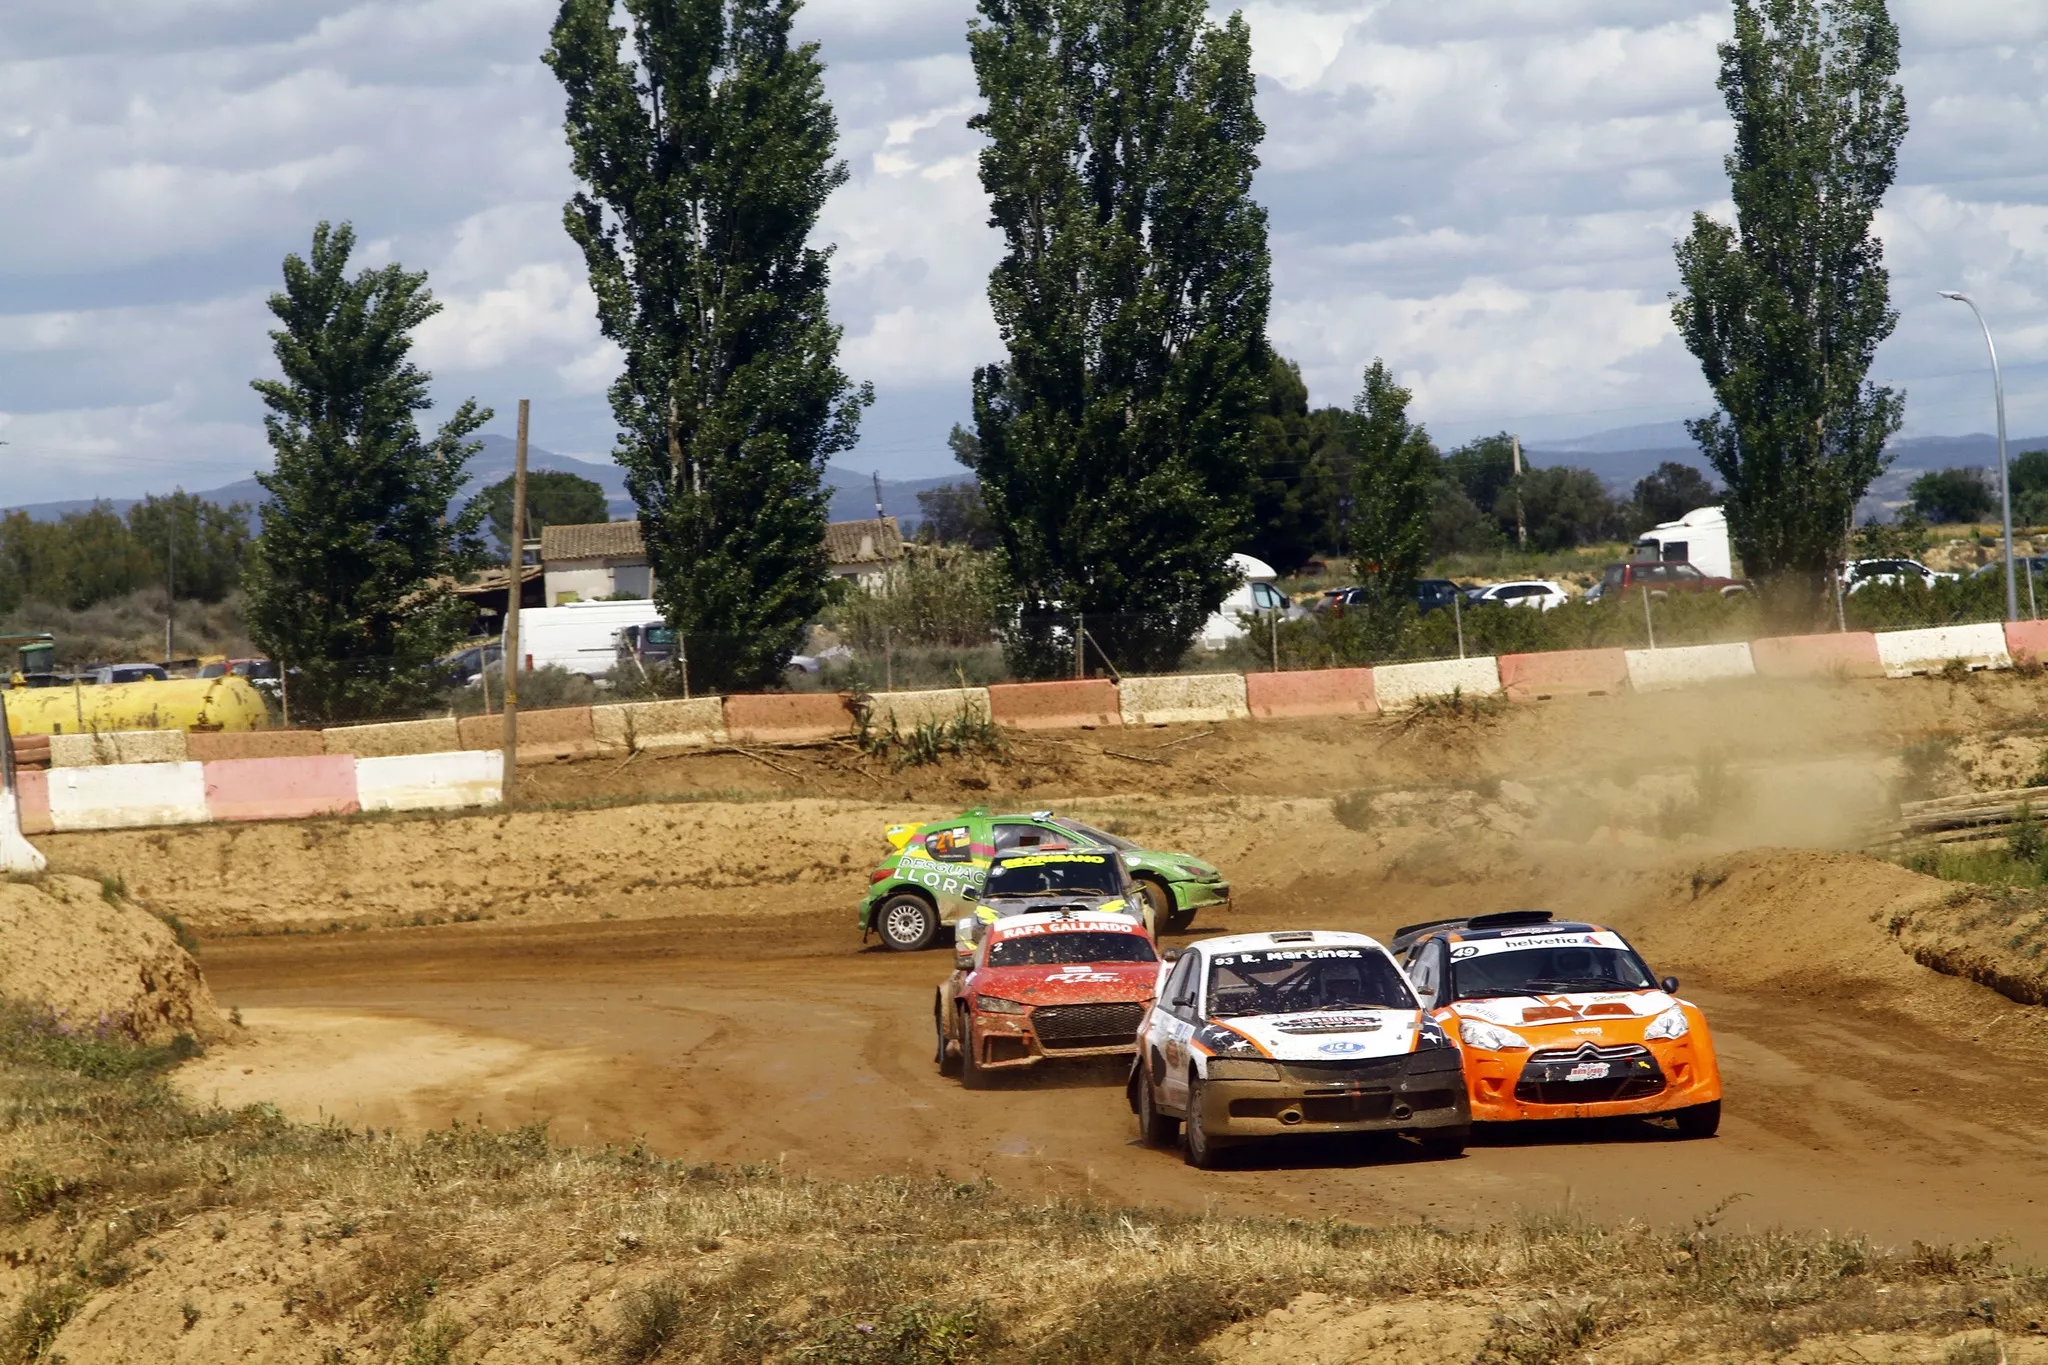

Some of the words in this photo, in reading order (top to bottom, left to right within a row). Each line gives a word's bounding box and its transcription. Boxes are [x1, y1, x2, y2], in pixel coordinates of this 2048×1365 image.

[1003, 925, 1046, 938] RAFA
[1049, 923, 1132, 933] GALLARDO
[993, 942, 1003, 952] 2
[1505, 936, 1578, 948] helvetia
[1452, 946, 1475, 958] 49
[1241, 954, 1261, 963] R.
